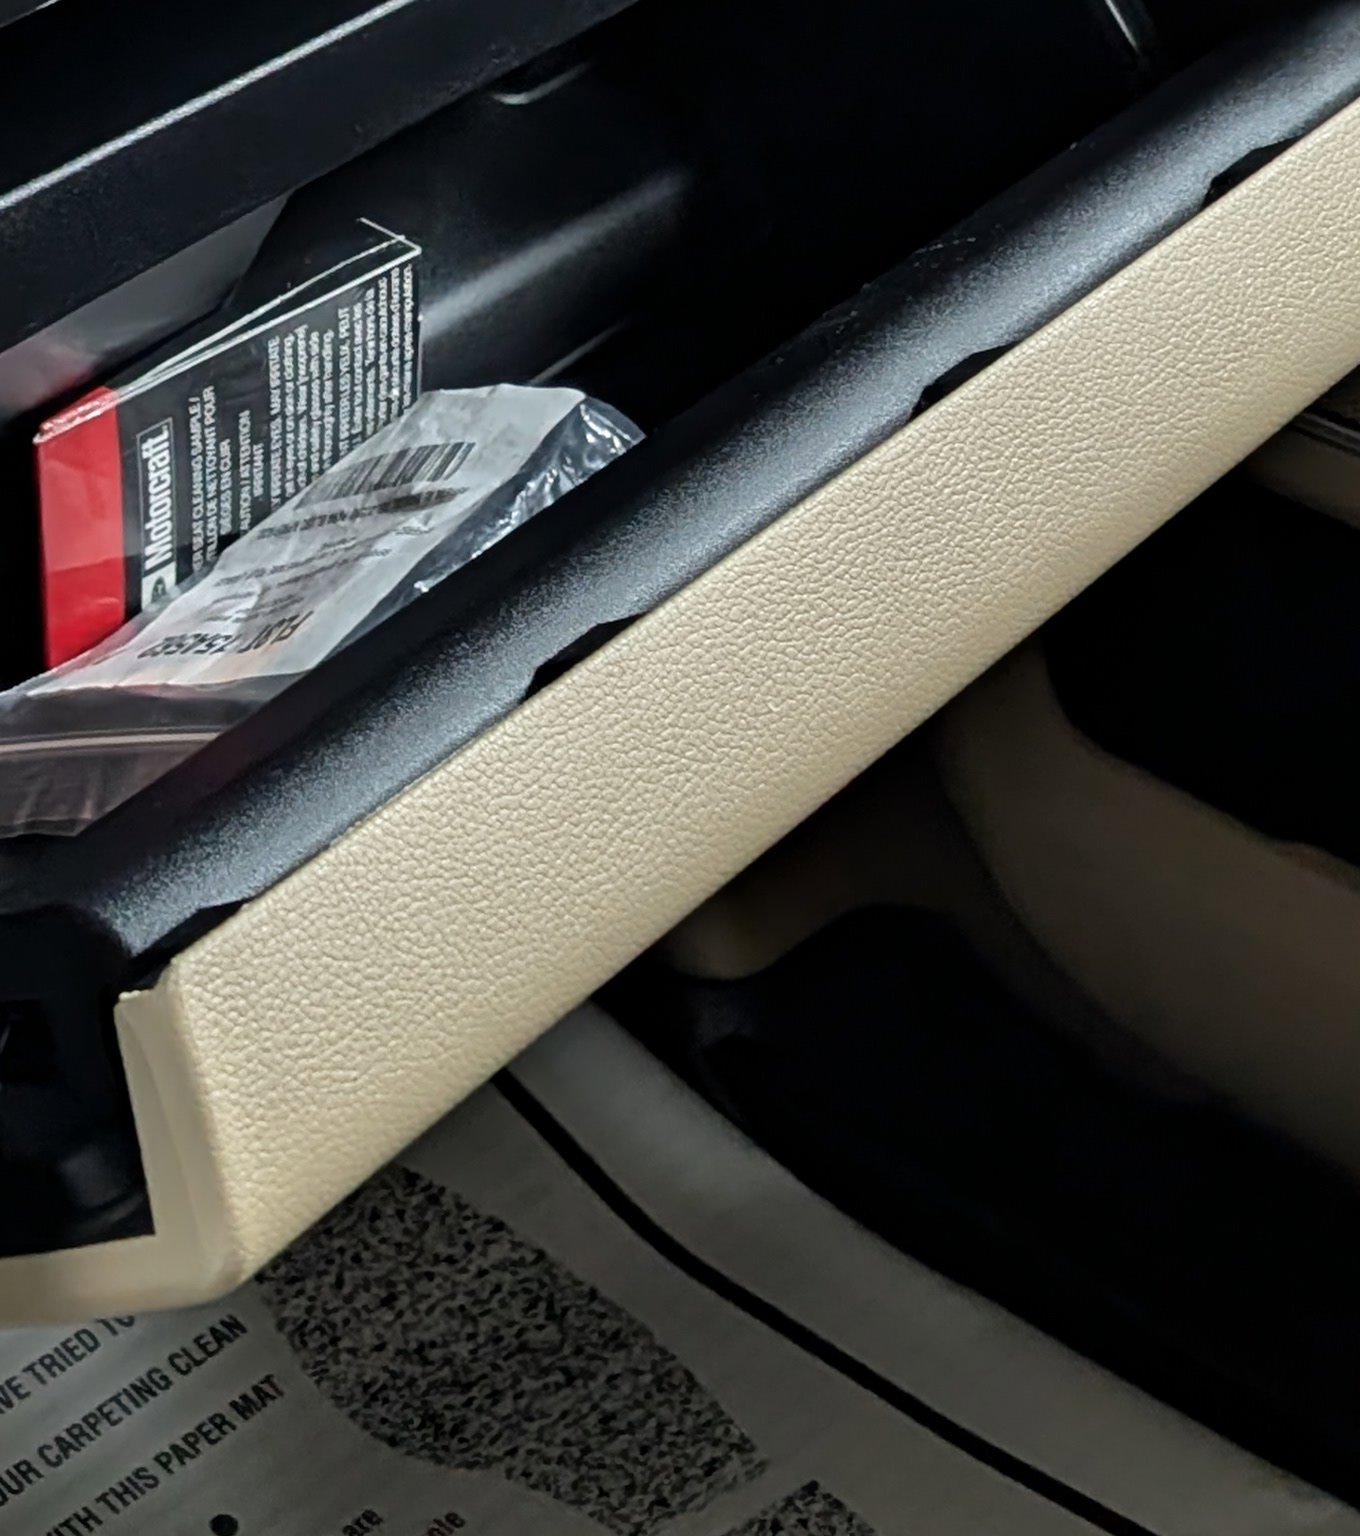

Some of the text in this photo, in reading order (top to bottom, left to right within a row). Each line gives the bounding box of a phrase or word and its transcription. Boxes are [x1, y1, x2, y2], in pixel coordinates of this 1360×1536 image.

[203, 386, 215, 425] POUR
[192, 457, 203, 519] CLEANING
[205, 427, 217, 497] NETTOYANT
[144, 426, 174, 571] Motorcraft
[240, 486, 251, 530] AUTION
[22, 1325, 101, 1389] TRIED
[36, 1366, 174, 1470] CARPETING
[167, 1313, 249, 1376] CLEAN
[94, 1465, 162, 1518] THIS
[152, 1411, 238, 1476] PAPER
[228, 1373, 287, 1422] MAT
